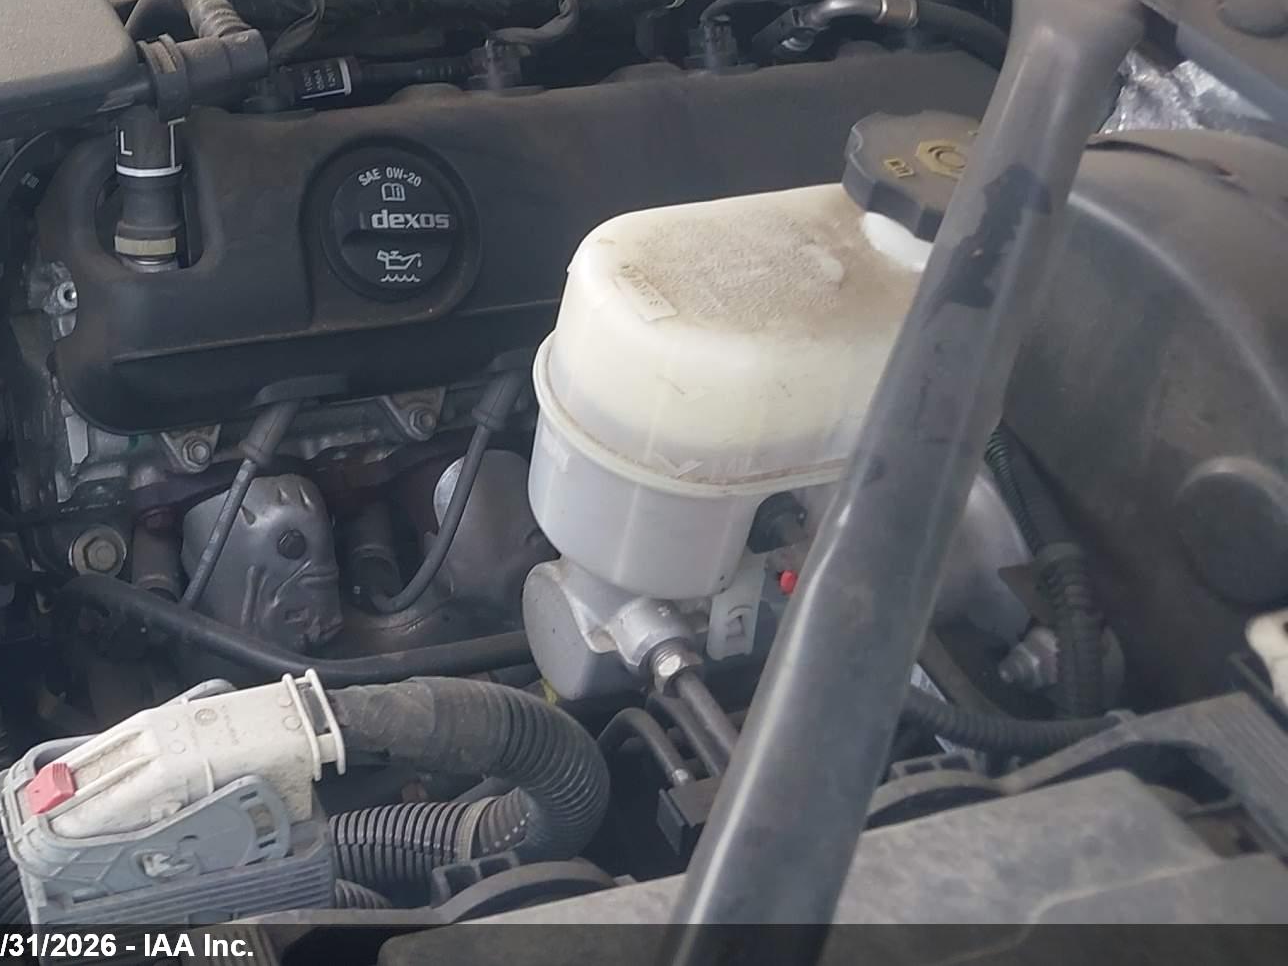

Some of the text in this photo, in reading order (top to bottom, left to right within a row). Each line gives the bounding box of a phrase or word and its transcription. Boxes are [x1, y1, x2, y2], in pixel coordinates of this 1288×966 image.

[120, 130, 133, 155] L
[358, 166, 422, 187] SAE 0W-20
[371, 209, 451, 229] dexos
